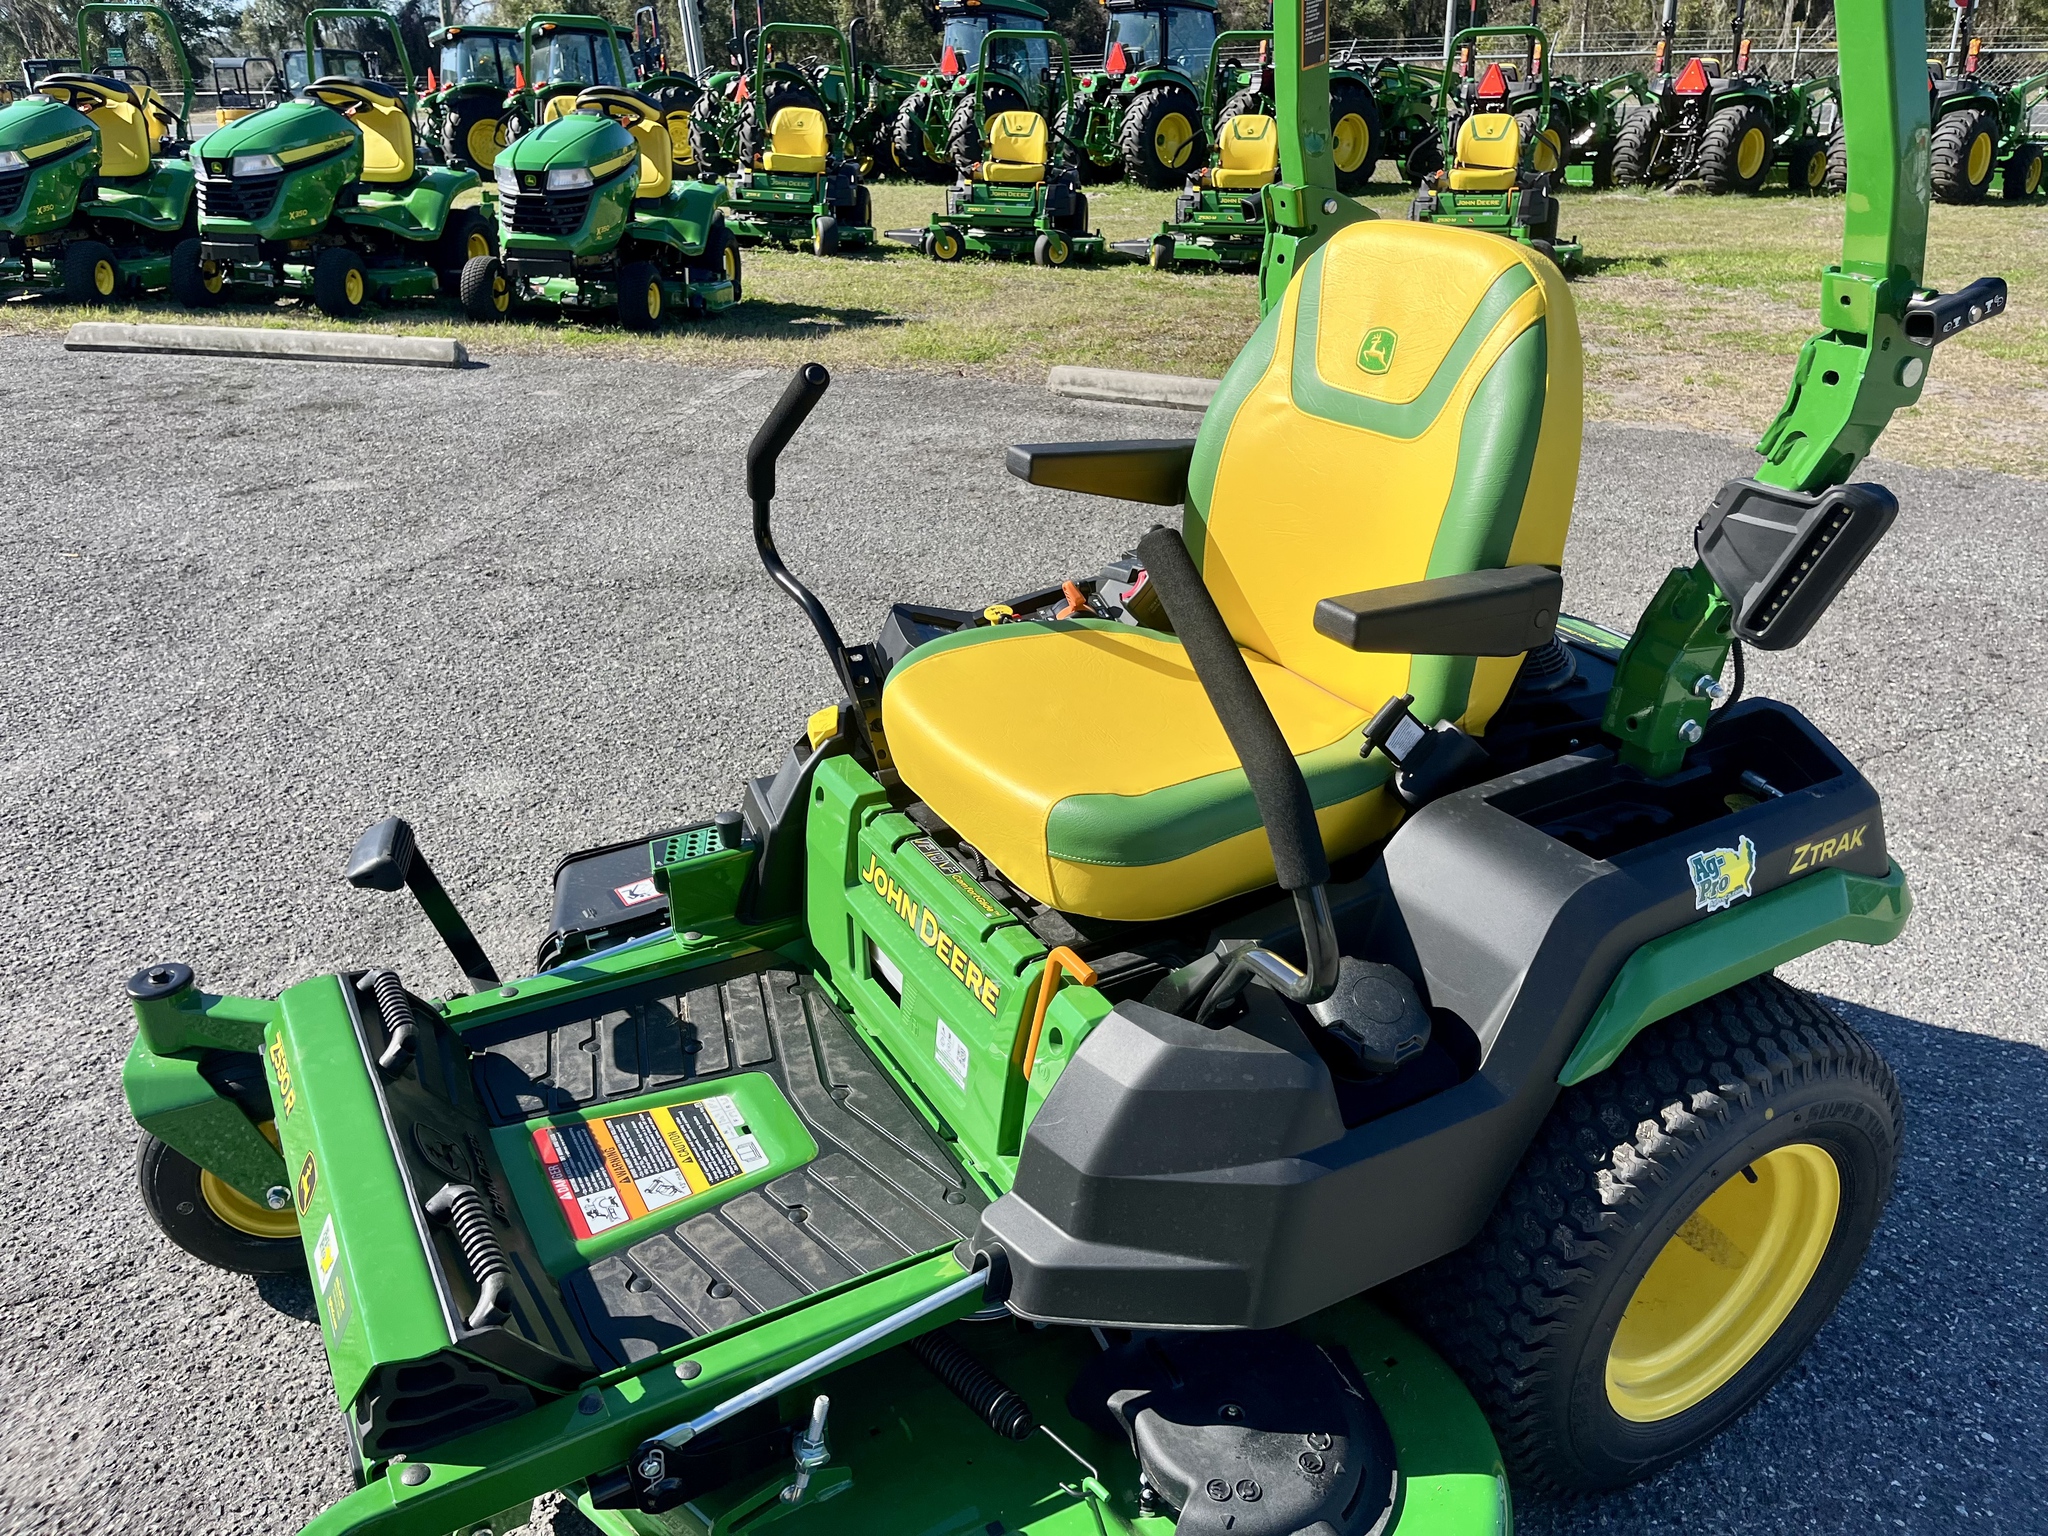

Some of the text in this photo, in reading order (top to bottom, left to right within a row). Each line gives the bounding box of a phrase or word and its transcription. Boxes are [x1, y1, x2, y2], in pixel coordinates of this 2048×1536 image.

[788, 180, 809, 188] DEERE
[36, 203, 55, 216] X350
[288, 209, 308, 221] X350
[1788, 825, 1867, 875] ZTRAK
[1699, 875, 1730, 903] Pro
[862, 852, 919, 931] JOHN
[919, 905, 1001, 1018] DEERE
[666, 1130, 688, 1158] CAUTION
[604, 1146, 630, 1181] WARNING
[547, 1163, 573, 1195] DANGER
